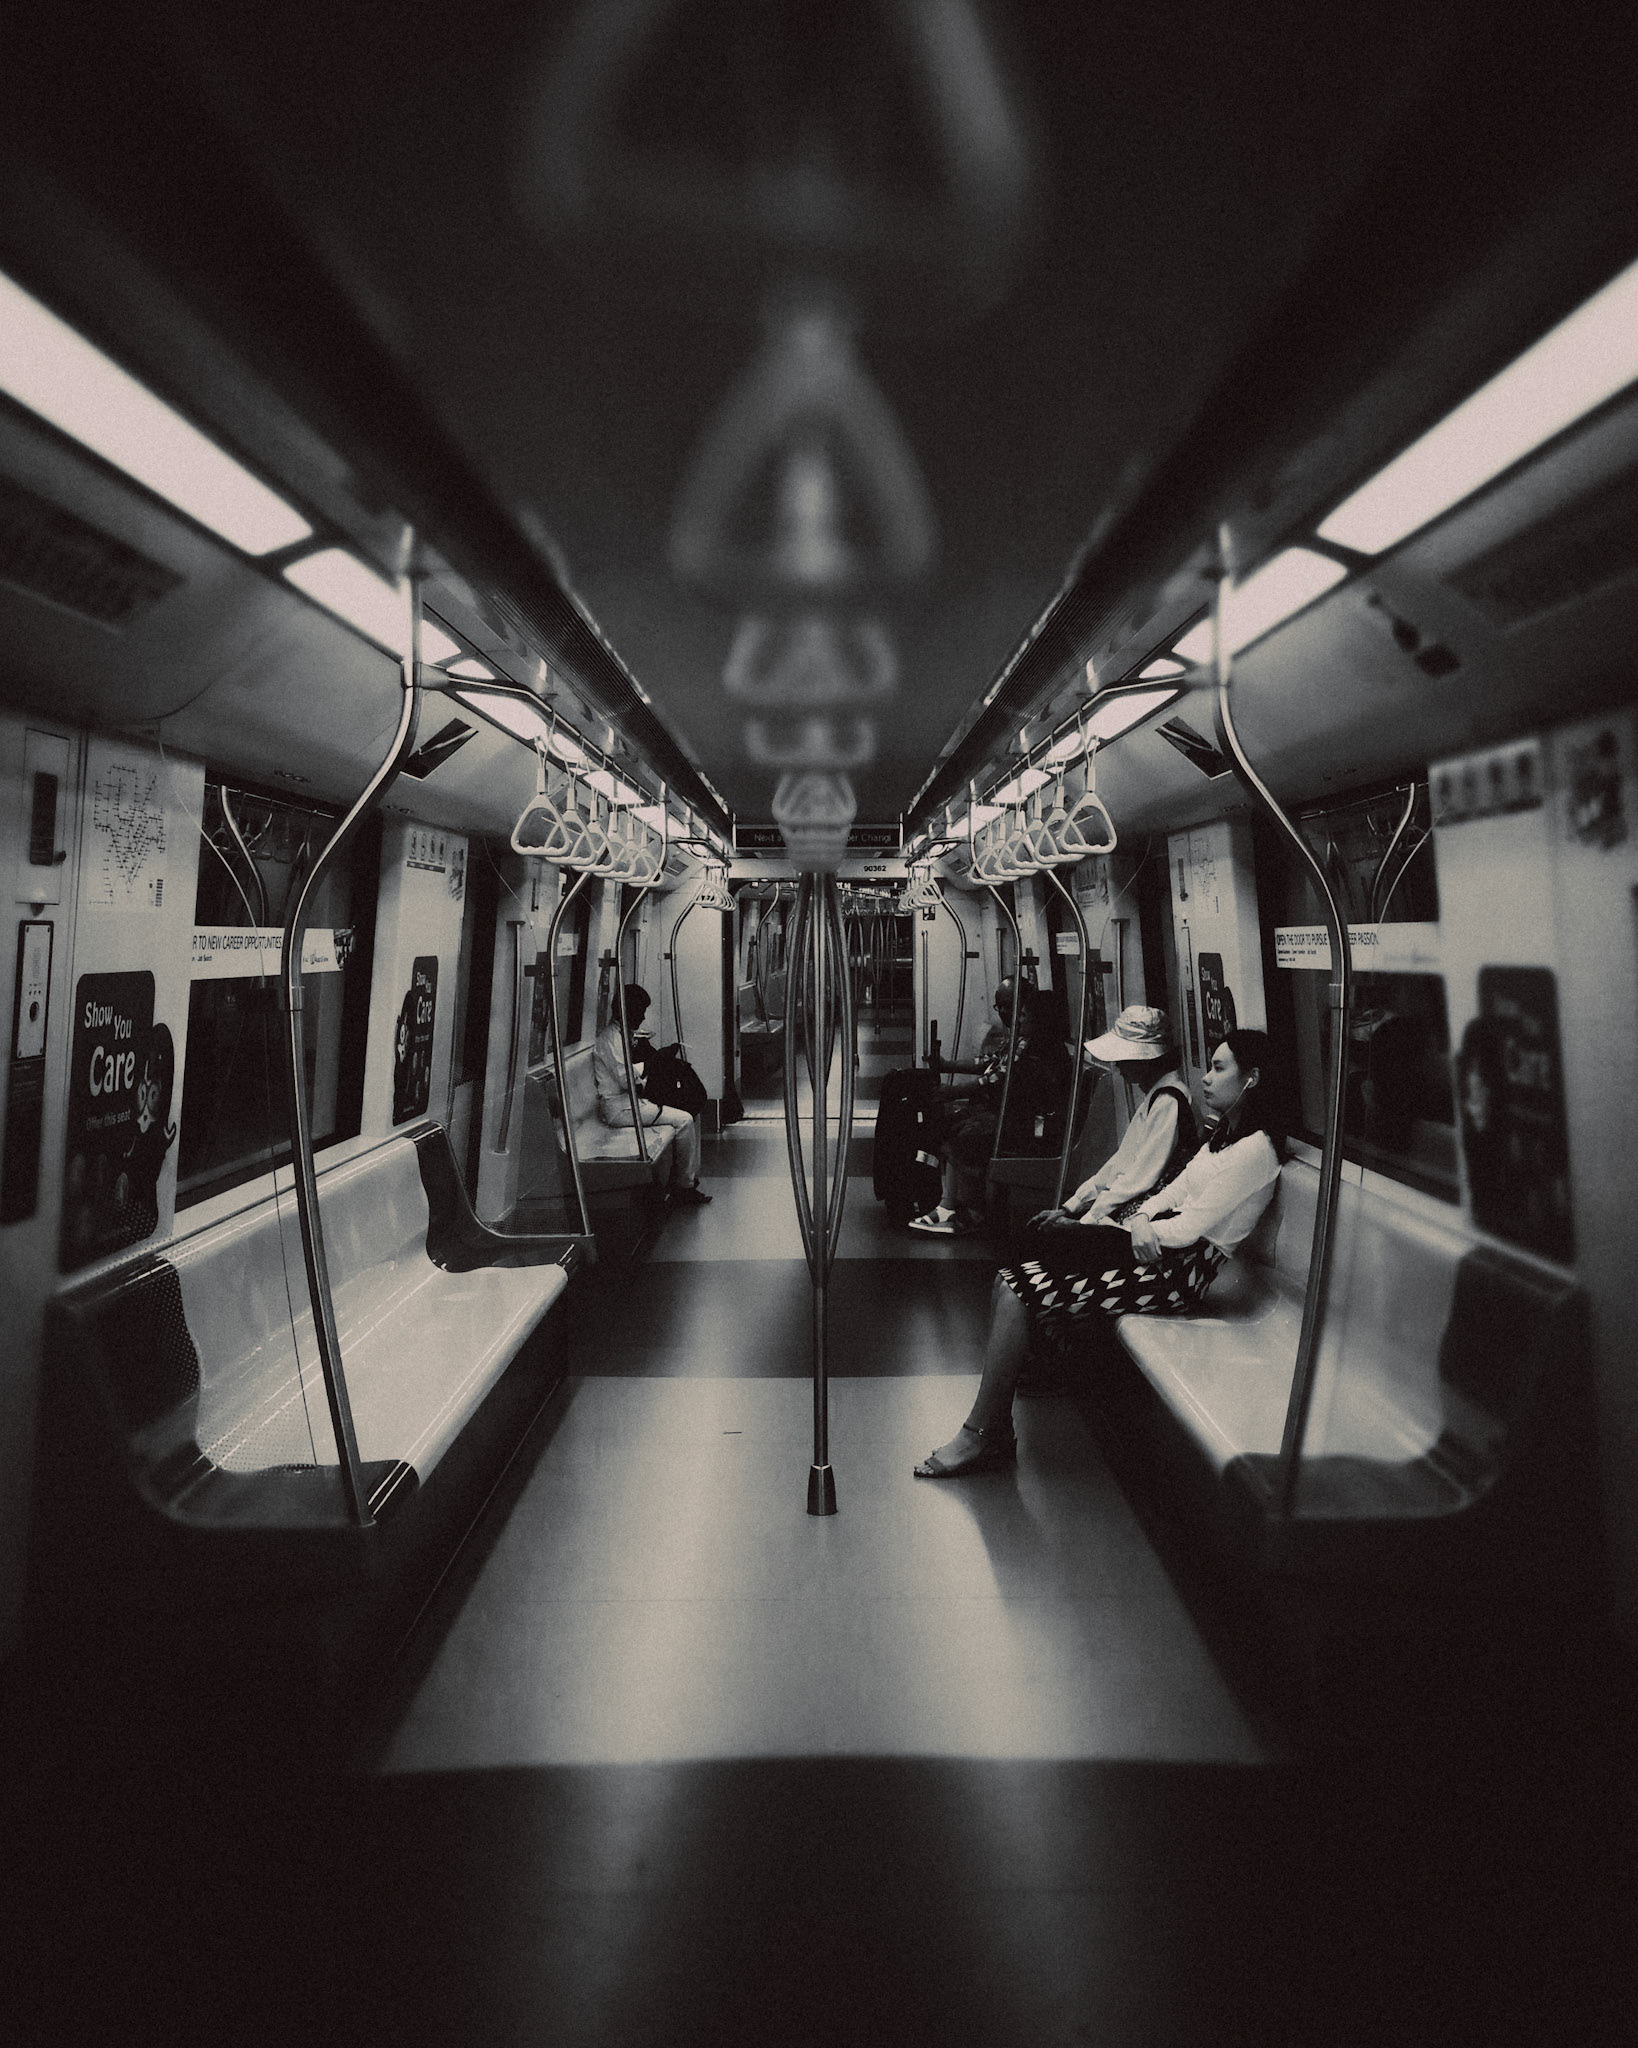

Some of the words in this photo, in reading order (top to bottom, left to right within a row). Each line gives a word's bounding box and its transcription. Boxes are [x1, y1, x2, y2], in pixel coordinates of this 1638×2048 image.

[199, 935, 207, 950] TO
[208, 935, 222, 950] NEW
[223, 935, 243, 949] CAREER
[245, 936, 282, 949] OPPORTUNITIES
[84, 1001, 114, 1029] Show
[114, 1015, 133, 1041] You
[416, 995, 432, 1025] Care
[89, 1045, 136, 1097] Care
[117, 1109, 131, 1124] seat
